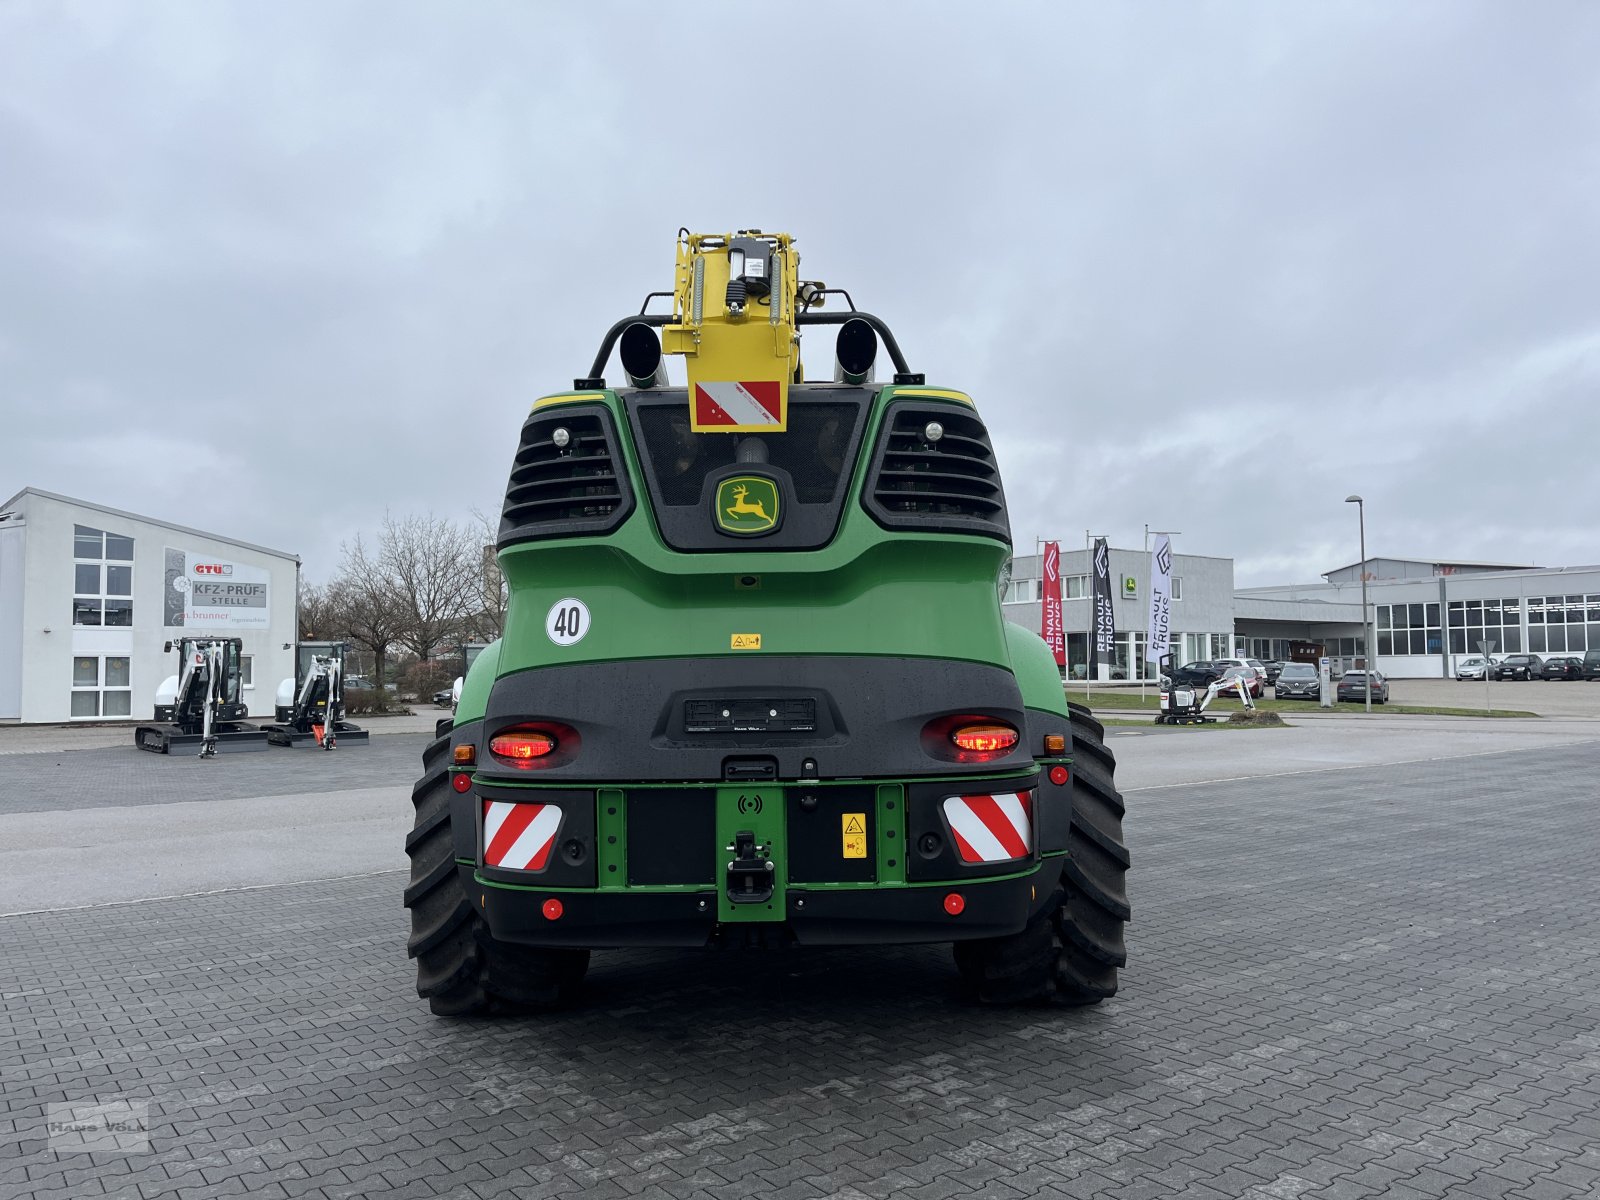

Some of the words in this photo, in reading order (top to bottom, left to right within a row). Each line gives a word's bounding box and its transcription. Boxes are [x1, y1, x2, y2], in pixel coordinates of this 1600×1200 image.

[195, 564, 222, 574] GTÜ
[192, 610, 229, 620] brunner
[211, 597, 249, 606] STELLE
[554, 606, 580, 637] 40
[1097, 592, 1105, 652] RENAULT
[1105, 599, 1114, 653] TRUCKS
[1157, 597, 1169, 650] TRUCKS
